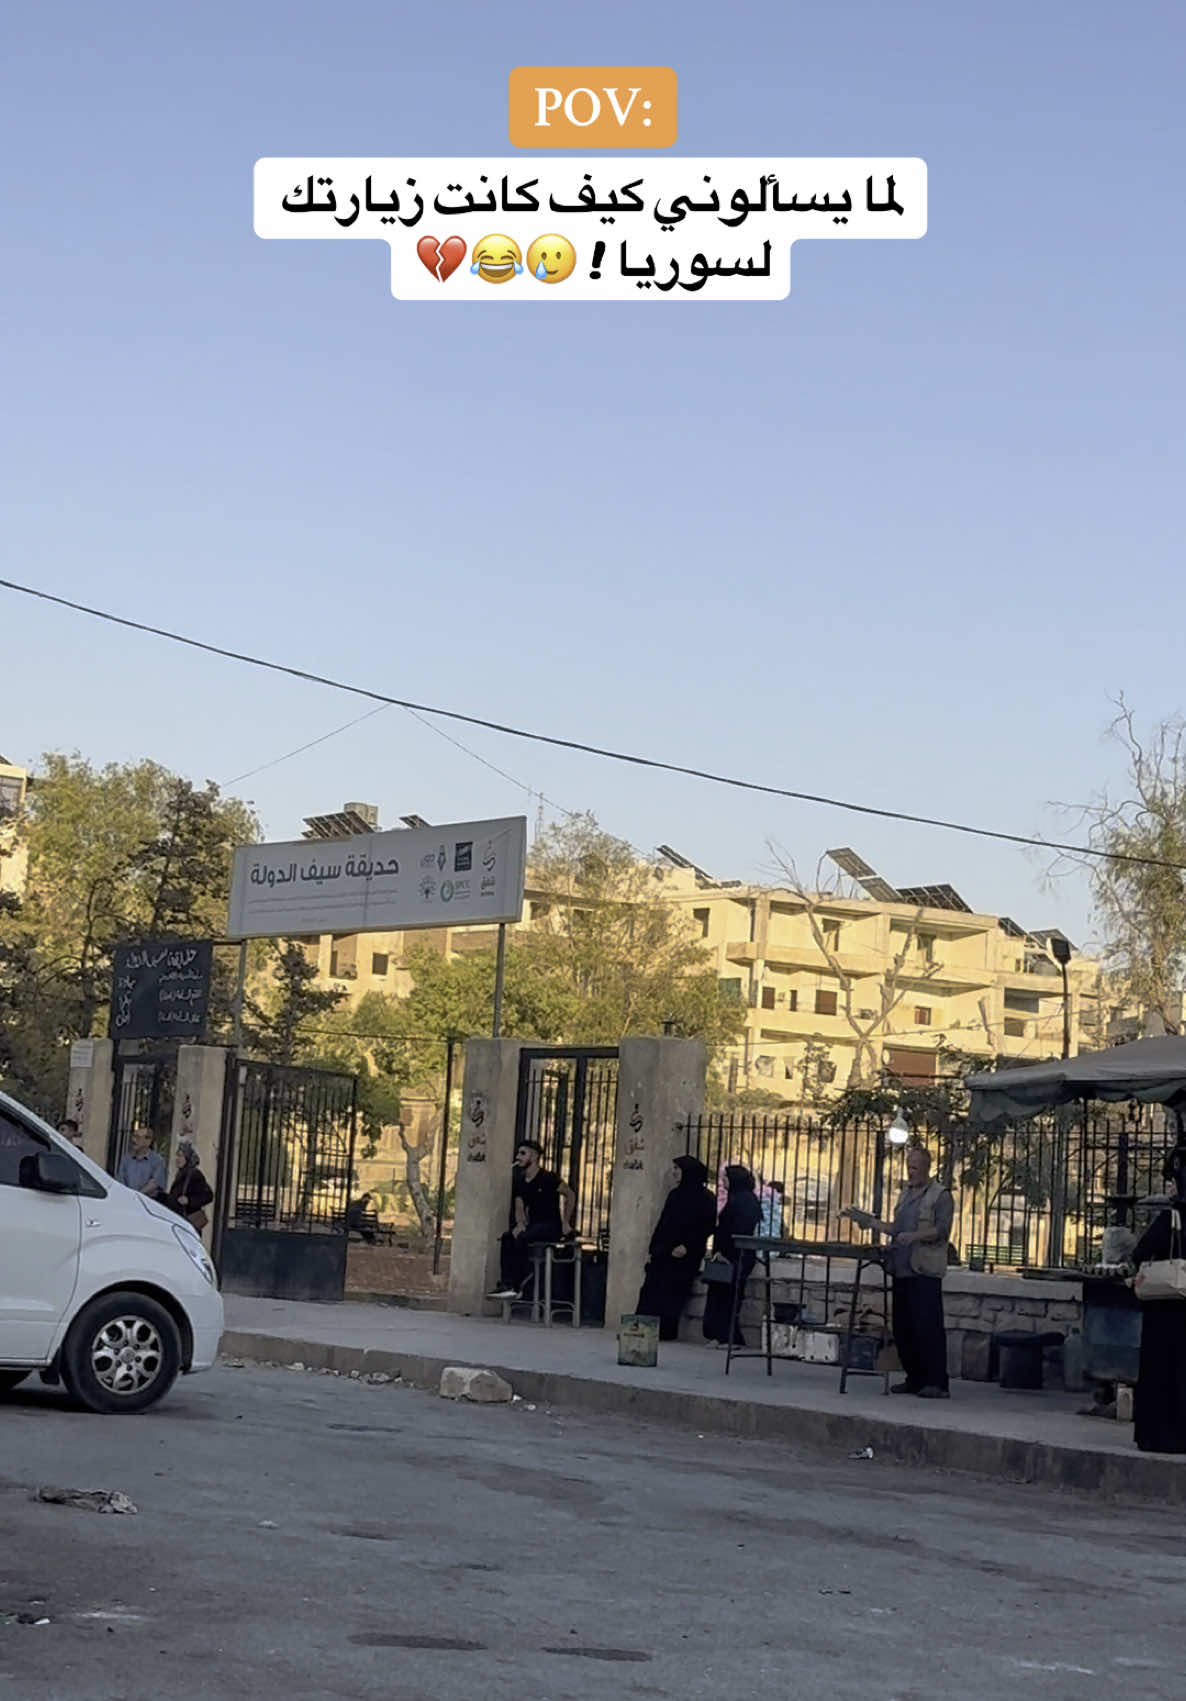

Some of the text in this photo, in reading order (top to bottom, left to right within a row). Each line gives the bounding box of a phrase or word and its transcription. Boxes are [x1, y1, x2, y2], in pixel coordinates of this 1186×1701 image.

[250, 853, 400, 888] حديقة سيف الدولة
